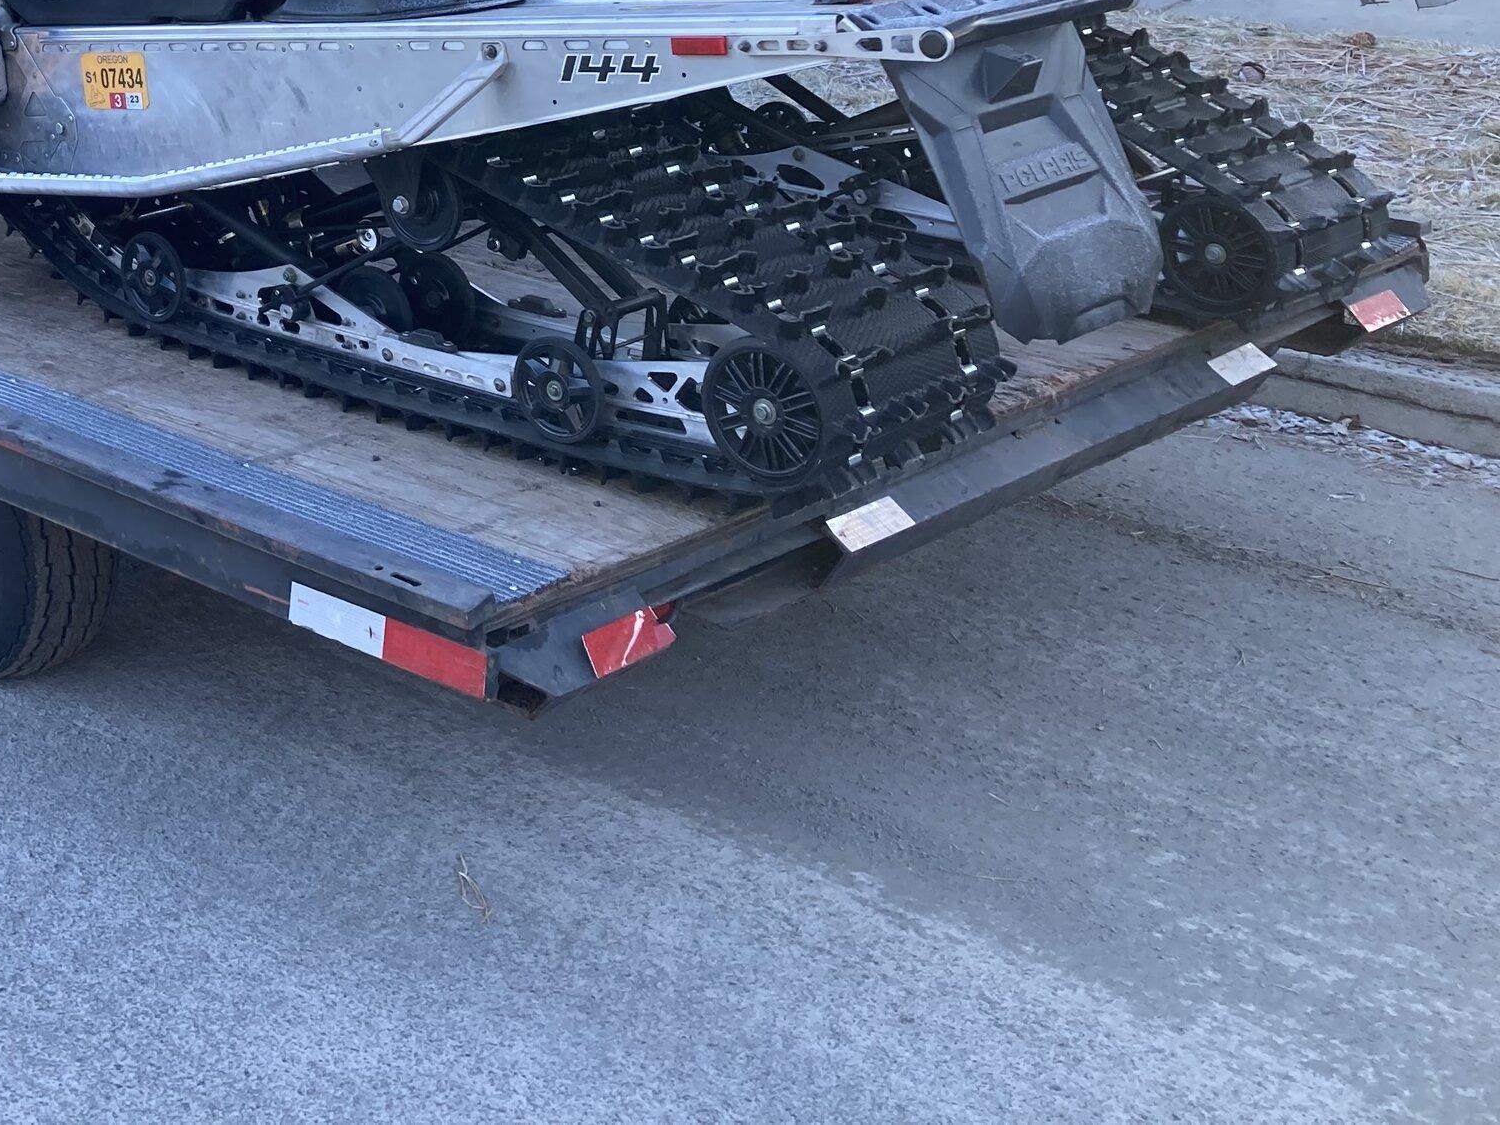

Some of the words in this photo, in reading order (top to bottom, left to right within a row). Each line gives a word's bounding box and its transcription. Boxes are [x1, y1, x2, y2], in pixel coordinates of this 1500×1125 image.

[97, 55, 128, 64] OREGON
[560, 54, 661, 84] 144
[85, 71, 97, 83] S1
[101, 67, 143, 89] 07434
[114, 94, 122, 108] 3
[129, 95, 139, 104] 23
[999, 151, 1089, 193] POLARIS
